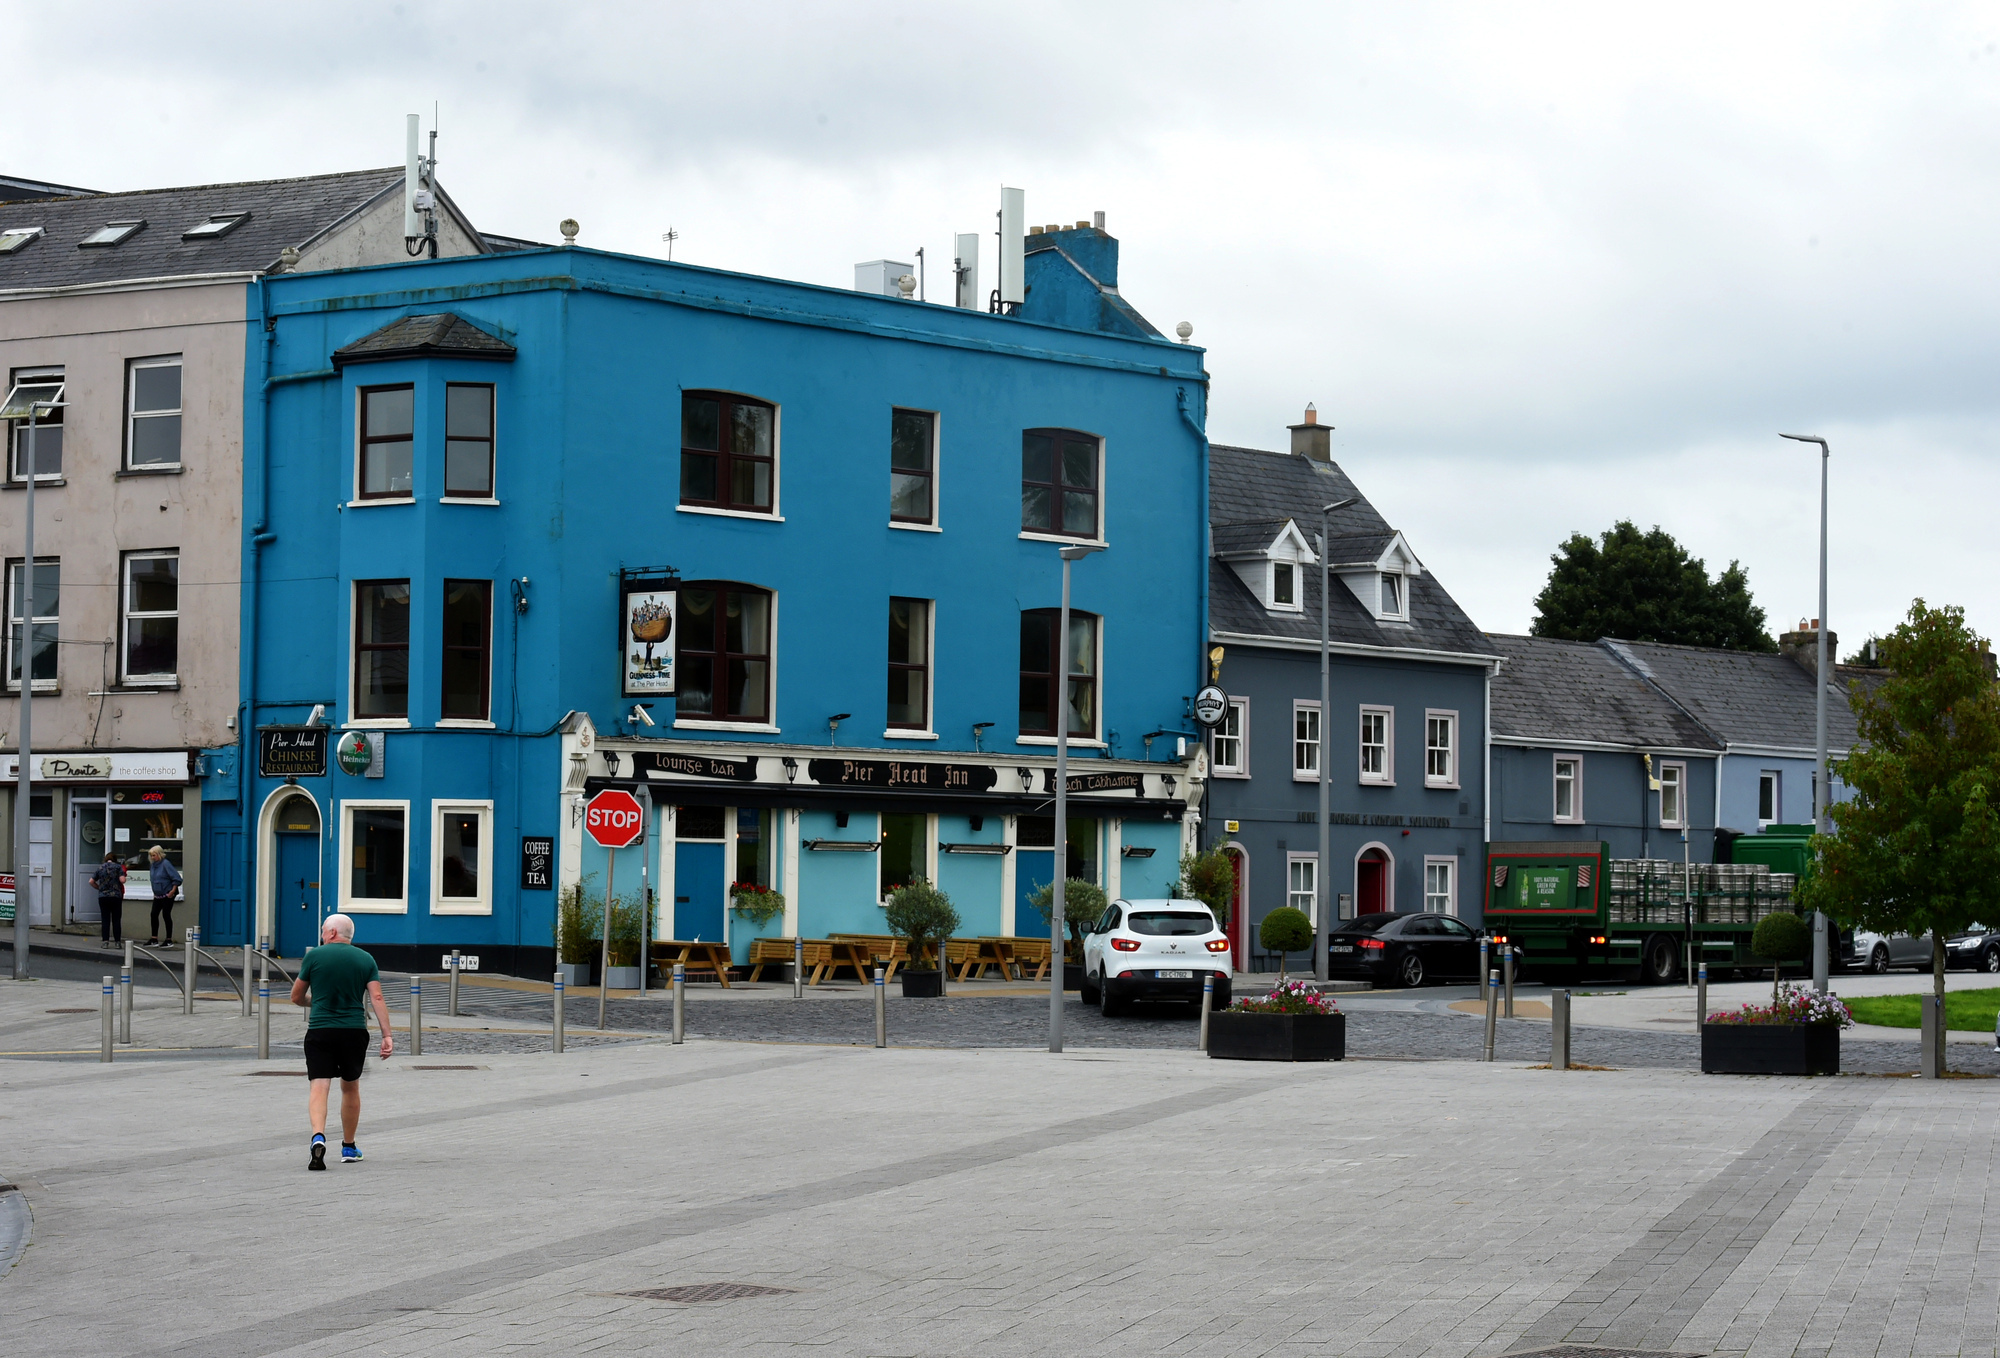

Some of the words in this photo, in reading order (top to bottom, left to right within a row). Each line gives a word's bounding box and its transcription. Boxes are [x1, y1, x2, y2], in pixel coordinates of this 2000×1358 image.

[657, 671, 671, 679] TIME
[270, 732, 289, 749] Pier
[290, 732, 317, 747] Head
[269, 749, 316, 762] CHINESE
[50, 759, 101, 776] Pronto
[119, 766, 131, 776] the
[133, 766, 156, 776] coffee
[157, 766, 177, 776] shop
[266, 763, 319, 773] RESTAURANT
[841, 761, 874, 783] Pier
[888, 762, 928, 787] Head
[944, 765, 969, 789] Inn
[1051, 778, 1083, 792] Tach
[142, 793, 164, 801] OPEN
[588, 808, 639, 829] STOP
[524, 841, 550, 855] COFFEE
[531, 858, 545, 868] AND
[526, 872, 547, 885] TEA
